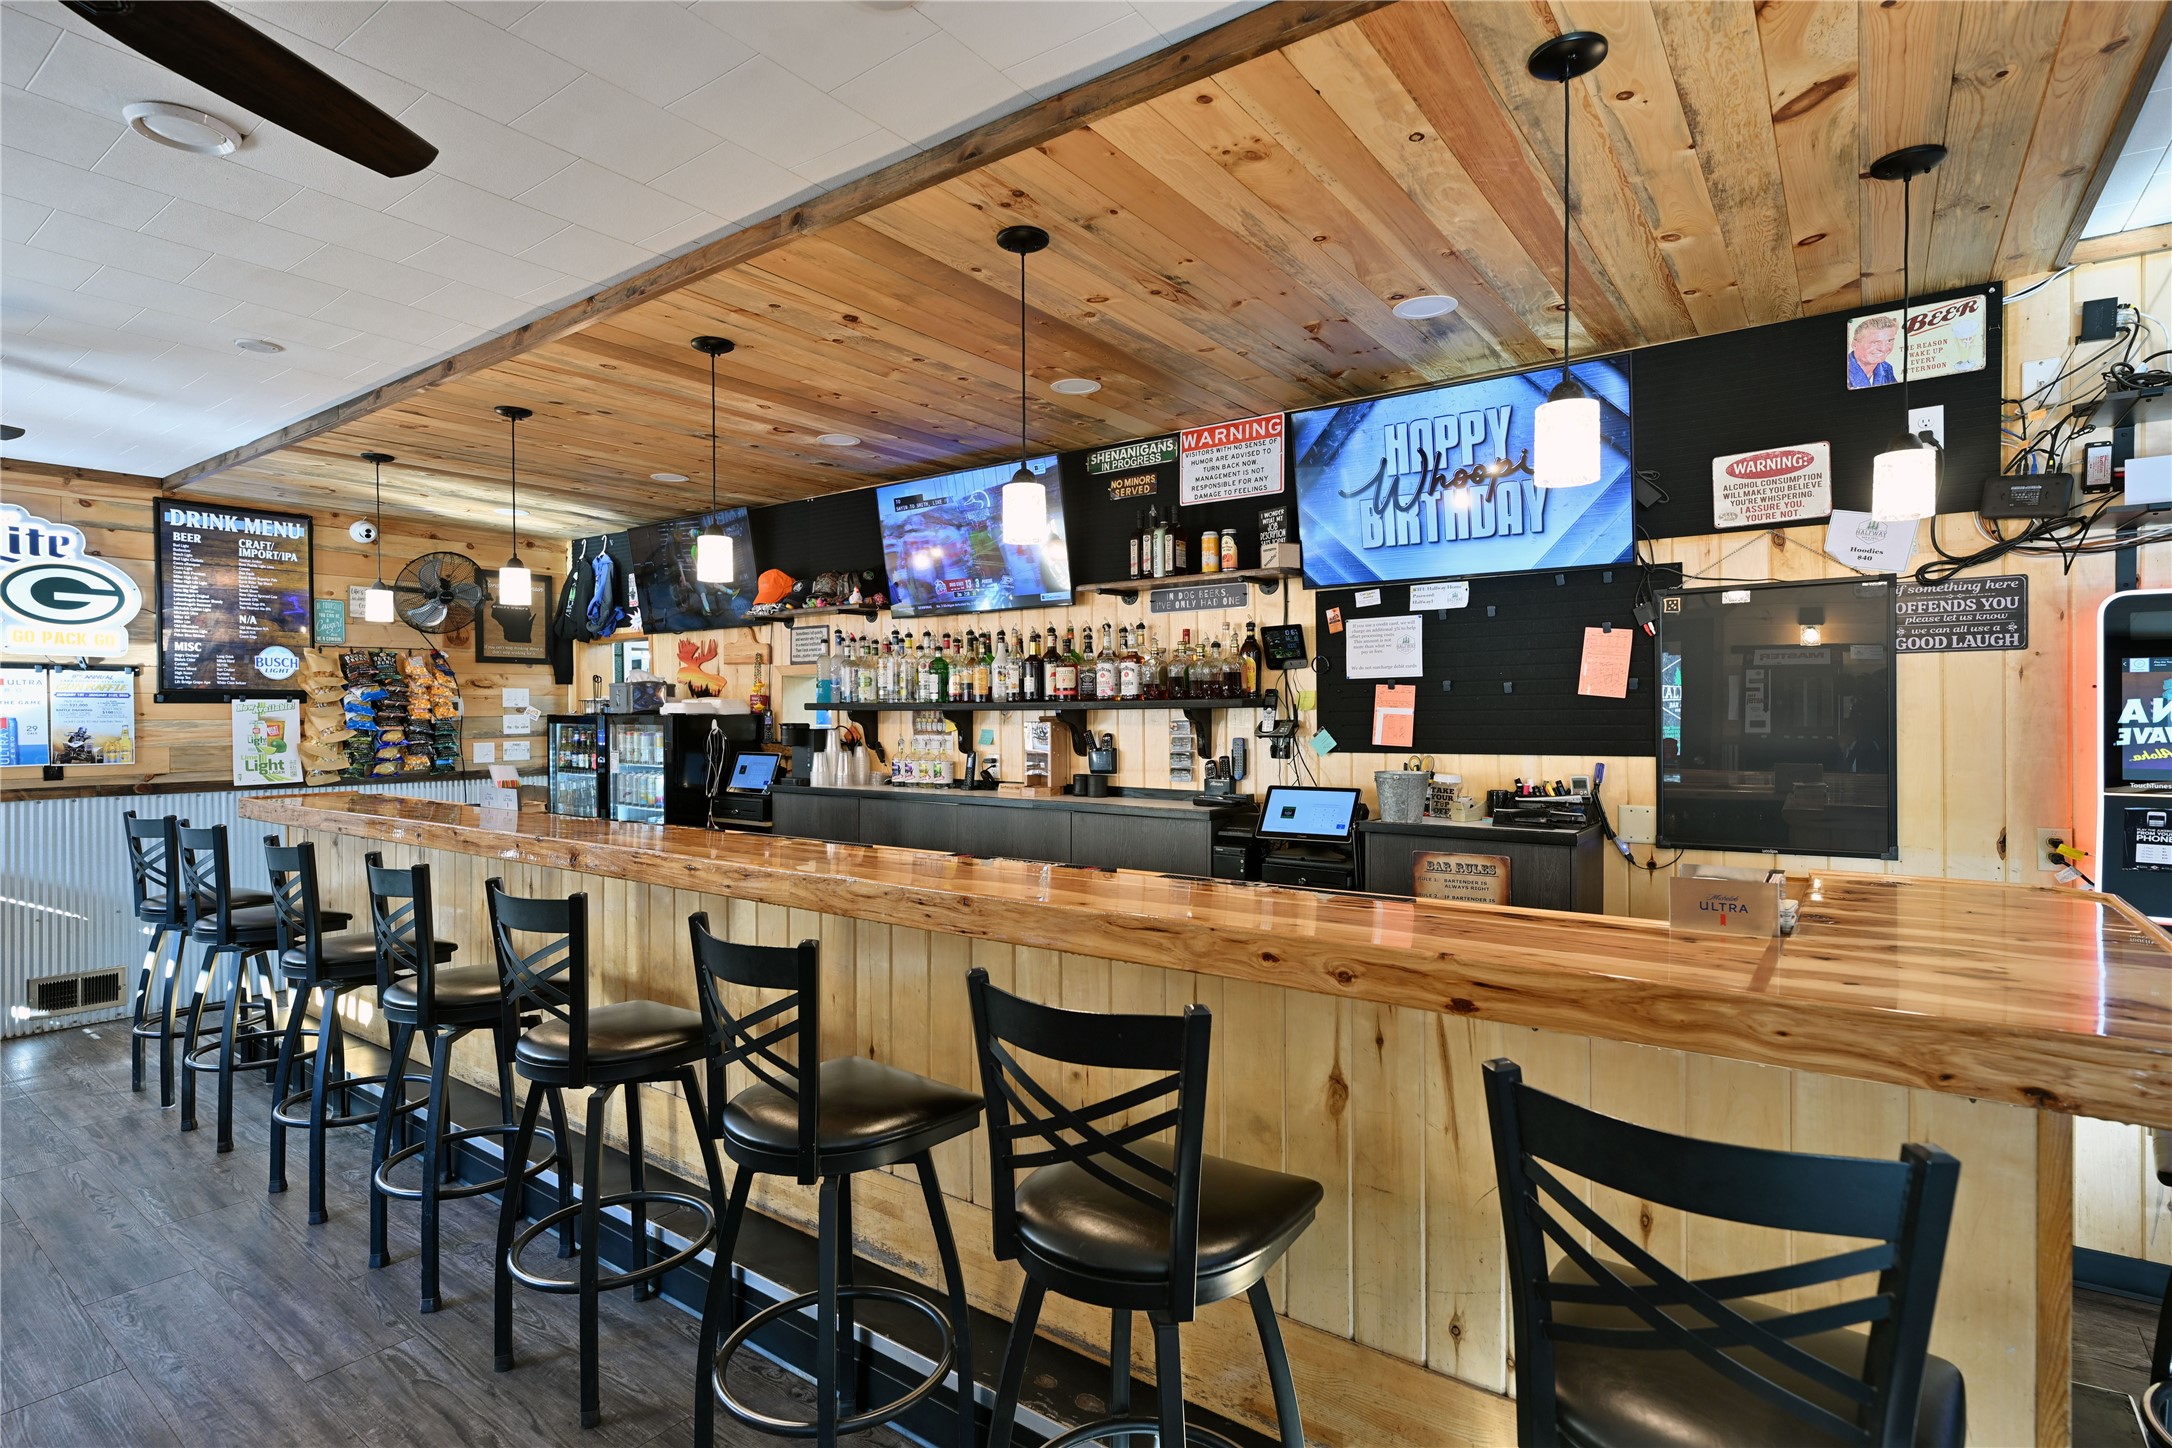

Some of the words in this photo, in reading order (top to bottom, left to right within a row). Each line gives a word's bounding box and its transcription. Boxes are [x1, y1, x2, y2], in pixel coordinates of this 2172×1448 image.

[1902, 300, 1979, 334] BEER
[1916, 339, 1948, 350] REASON
[1909, 350, 1931, 358] WAKE
[1911, 356, 1936, 366] EVERY
[1183, 419, 1281, 449] WARNING
[1091, 440, 1174, 465] SHENANIGANS
[1185, 449, 1214, 458] VISITORS
[1245, 440, 1266, 448] SENSE
[1102, 462, 1110, 471] IN
[1112, 453, 1161, 469] PROGRESS
[1191, 456, 1213, 466] HUMOR
[1231, 450, 1260, 460] ADVISED
[1733, 454, 1808, 475] WARNING:
[1203, 464, 1220, 473] TURN
[1222, 462, 1240, 470] BACK
[1242, 459, 1259, 467] NOW.
[1111, 480, 1123, 489] NO
[1124, 474, 1156, 487] MINORS
[1195, 471, 1240, 482] MANAGEMENT
[1723, 481, 1759, 492] ALCOHOL
[1760, 473, 1822, 487] CONSUMPTION
[1115, 485, 1150, 497] SERVED
[1192, 479, 1236, 492] RESPONSIBLE
[1723, 492, 1742, 500] WILL
[1743, 488, 1767, 498] MAKE
[1769, 486, 1785, 495] YOU
[1787, 480, 1822, 492] BELIEVE
[1194, 491, 1221, 500] DAMAGE
[1234, 485, 1268, 494] FEELINGS
[1730, 498, 1758, 507] YOU'RE
[1760, 491, 1815, 503] WHISPERING.
[1264, 509, 1284, 518] WONDER
[1359, 478, 1549, 550] BIRTHDAY
[1745, 503, 1781, 514] ASSURE
[1262, 517, 1275, 525] WHAT
[1745, 511, 1777, 522] YOU'RE
[1780, 509, 1802, 518] NOT.
[170, 508, 239, 533] DRINK
[244, 517, 301, 539] MENU
[1268, 522, 1278, 531] JOB
[173, 532, 201, 543] BEER
[1260, 529, 1286, 540] DESCRIPTION
[1856, 529, 1886, 537] HALFWAY
[2, 526, 70, 560] ite
[239, 539, 275, 550] CRAFT/
[239, 548, 298, 562] IMPORT/IPA
[1850, 547, 1884, 555] Hoodies
[965, 580, 972, 589] 13
[975, 579, 980, 588] 3
[1896, 585, 1907, 596] if
[1907, 582, 1981, 593] something
[1986, 580, 2019, 590] here
[1179, 590, 1195, 599] DOG
[1199, 588, 1230, 598] BEERS,
[1156, 601, 1171, 610] I'VE
[1175, 599, 1196, 609] ONLY
[1200, 597, 1219, 607] HAD
[1222, 596, 1240, 606] ONE
[1896, 599, 1977, 614] OFFENDS
[1980, 596, 2020, 610] YOU
[239, 615, 257, 625] N/A
[1905, 615, 1940, 625] please
[1976, 612, 2008, 620] know
[1953, 625, 1968, 633] all
[12, 629, 35, 643] GO
[41, 631, 87, 645] PACK
[94, 633, 115, 647] GO
[1896, 636, 1948, 650] GOOD
[1952, 633, 2020, 648] LAUGH
[174, 642, 202, 652] MISC
[255, 656, 299, 669] BUSCH
[236, 704, 253, 712] Now
[245, 759, 285, 775] Light
[1431, 787, 1454, 795] TAKE
[2130, 782, 2172, 790] TouchTunes
[1426, 861, 1452, 872] BAR
[1455, 863, 1496, 875] RULES
[1451, 895, 1487, 903] BARTENDER
[1700, 901, 1748, 914] ULTRA
